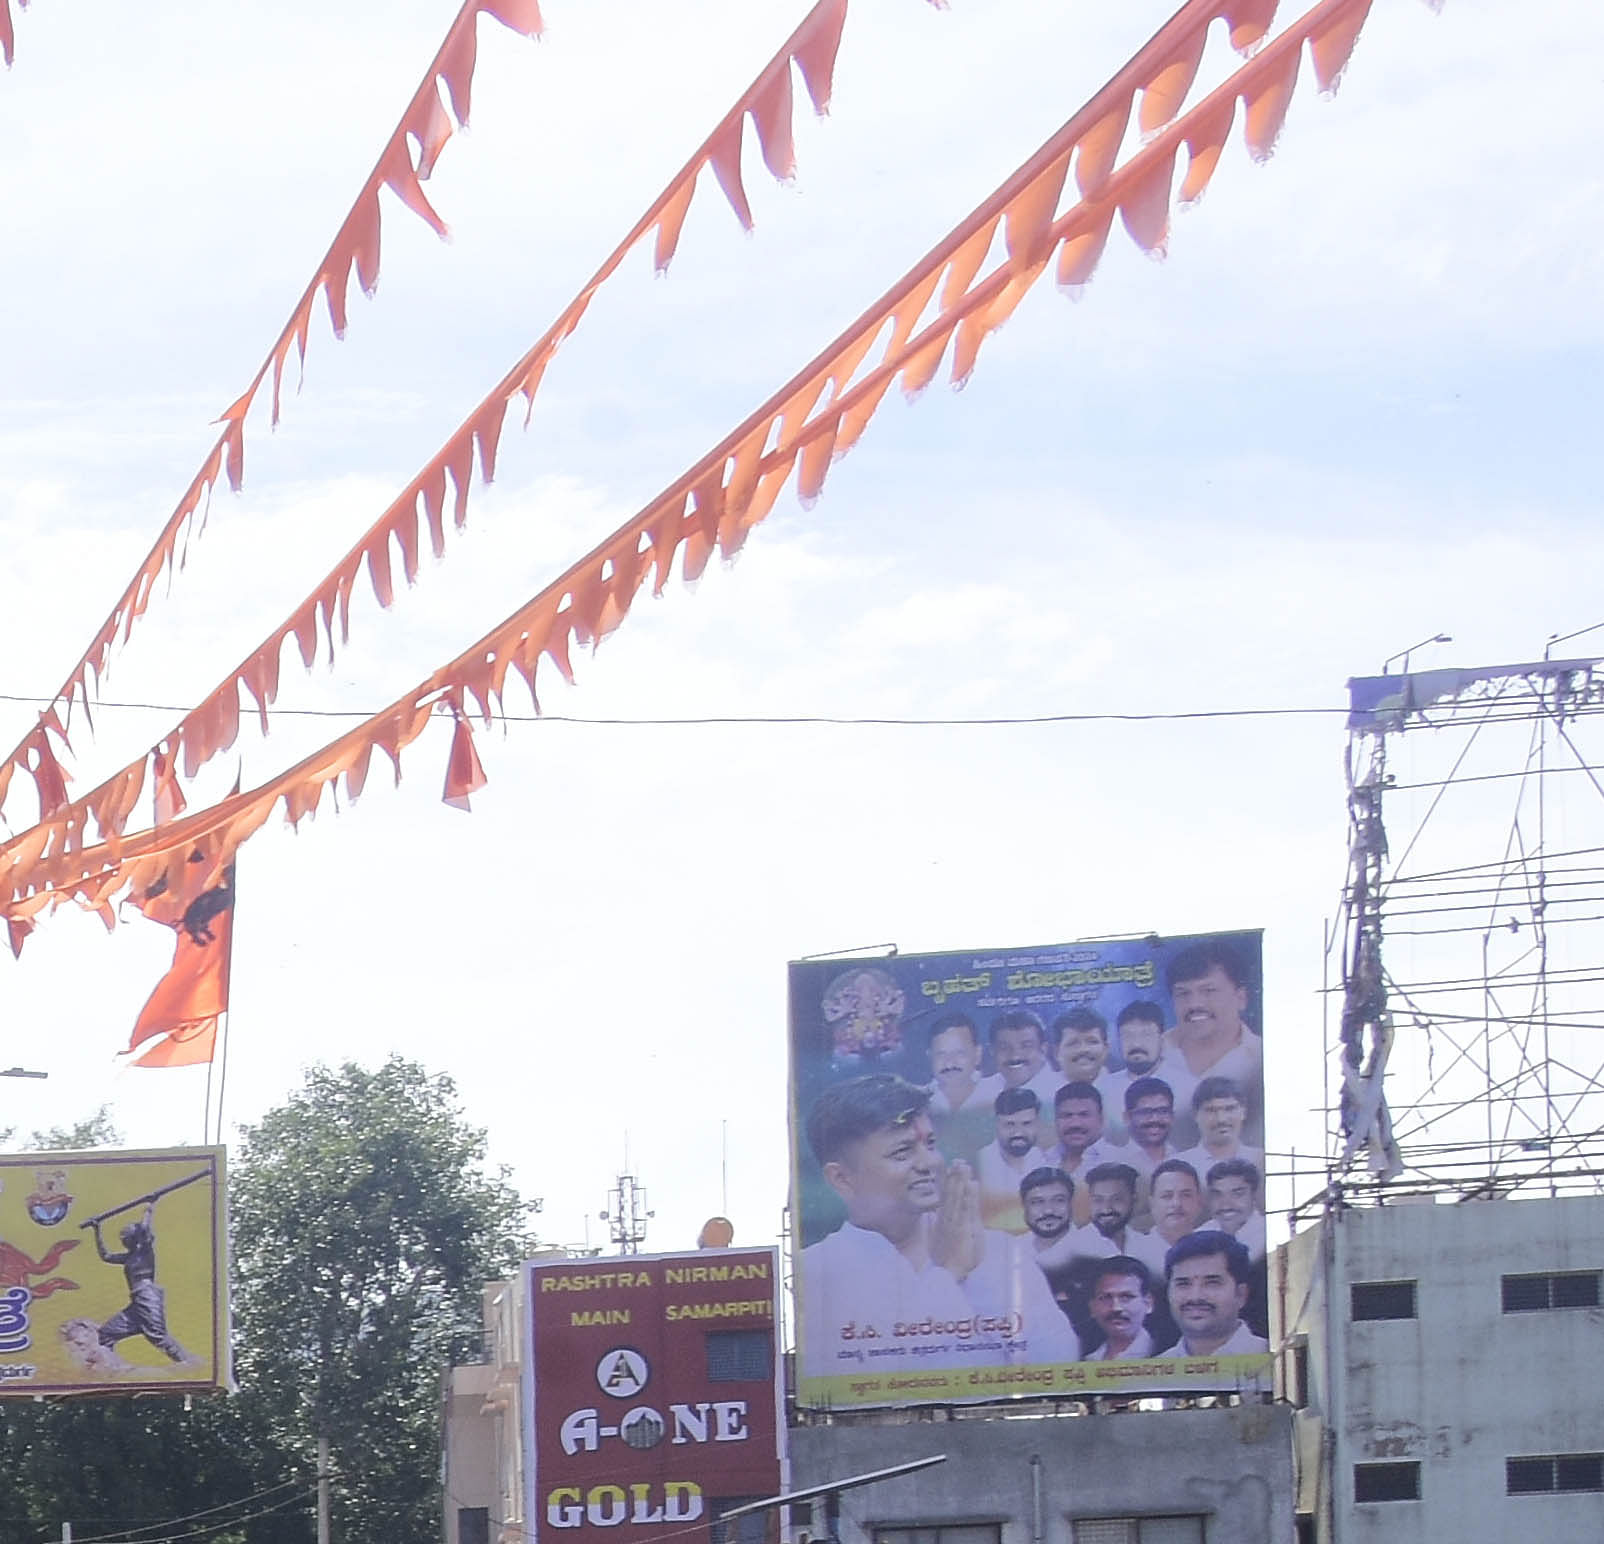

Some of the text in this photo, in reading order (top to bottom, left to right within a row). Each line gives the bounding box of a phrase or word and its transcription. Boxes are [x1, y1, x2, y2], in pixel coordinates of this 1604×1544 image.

[542, 1264, 769, 1293] RASHTRA NIRMAN
[571, 1309, 631, 1326] MAIN
[547, 1481, 704, 1528] GOLD
